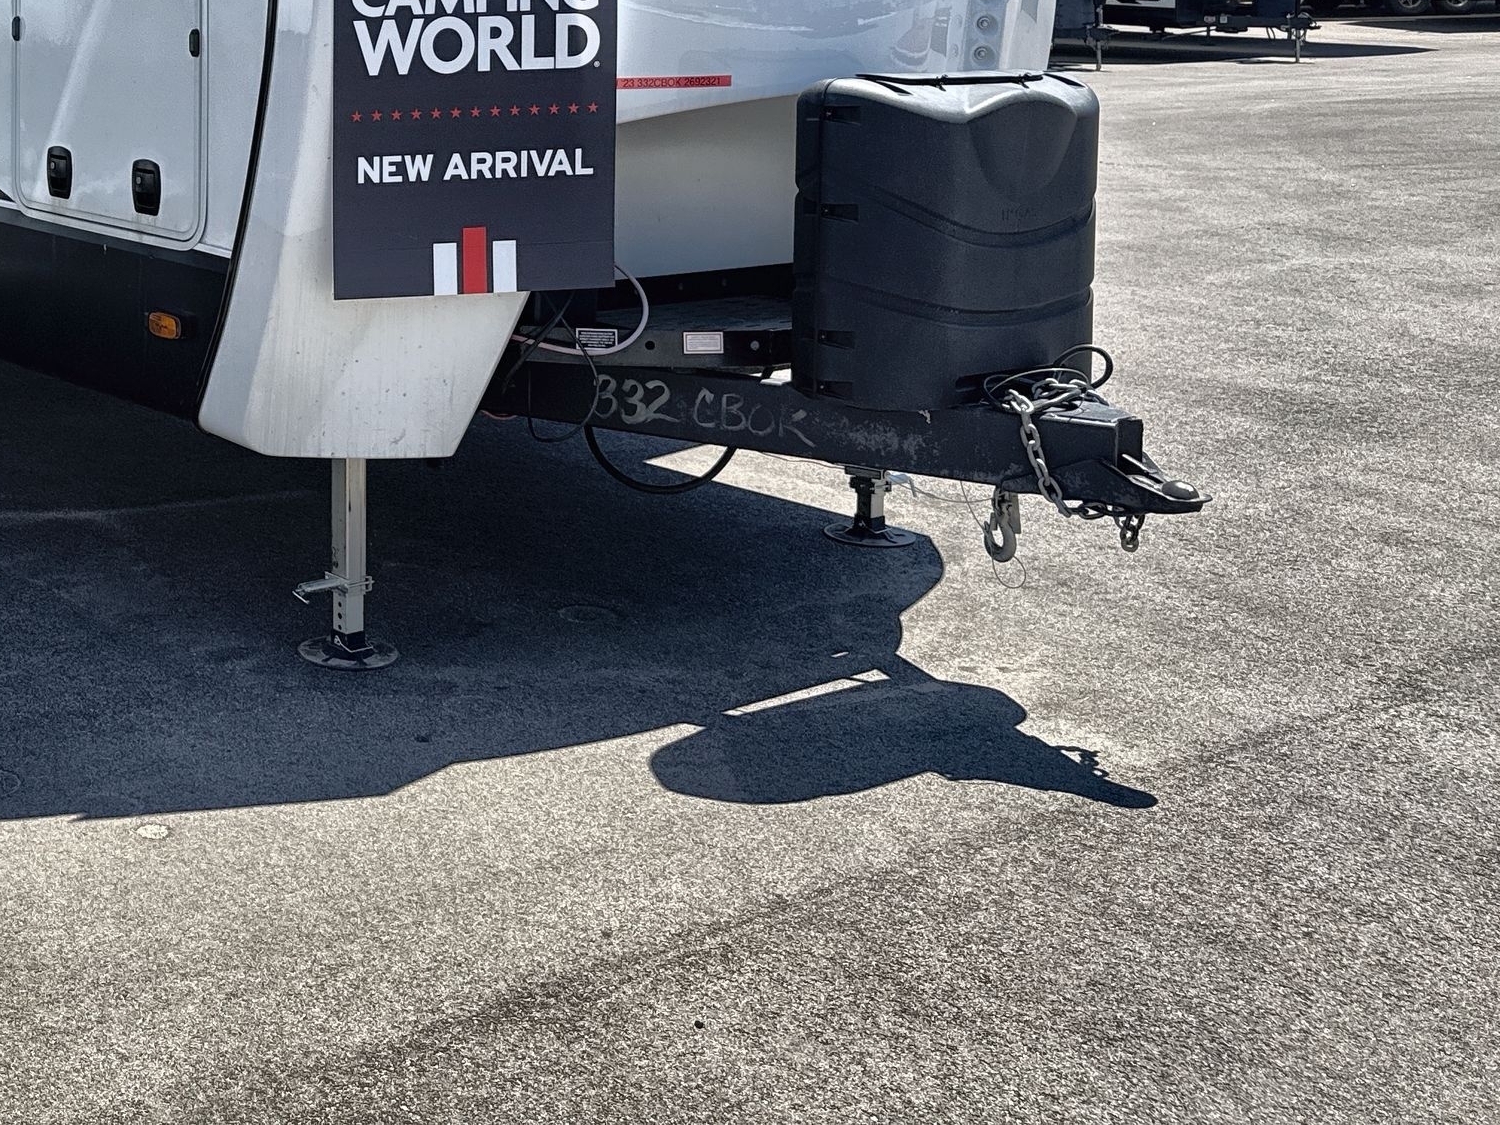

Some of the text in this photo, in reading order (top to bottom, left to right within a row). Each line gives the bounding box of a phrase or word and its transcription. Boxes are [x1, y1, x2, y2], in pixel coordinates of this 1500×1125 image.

[353, 13, 600, 76] WORLD
[622, 76, 721, 88] 23 332CBOK 2692321
[357, 148, 594, 184] NEW ARRIVAL
